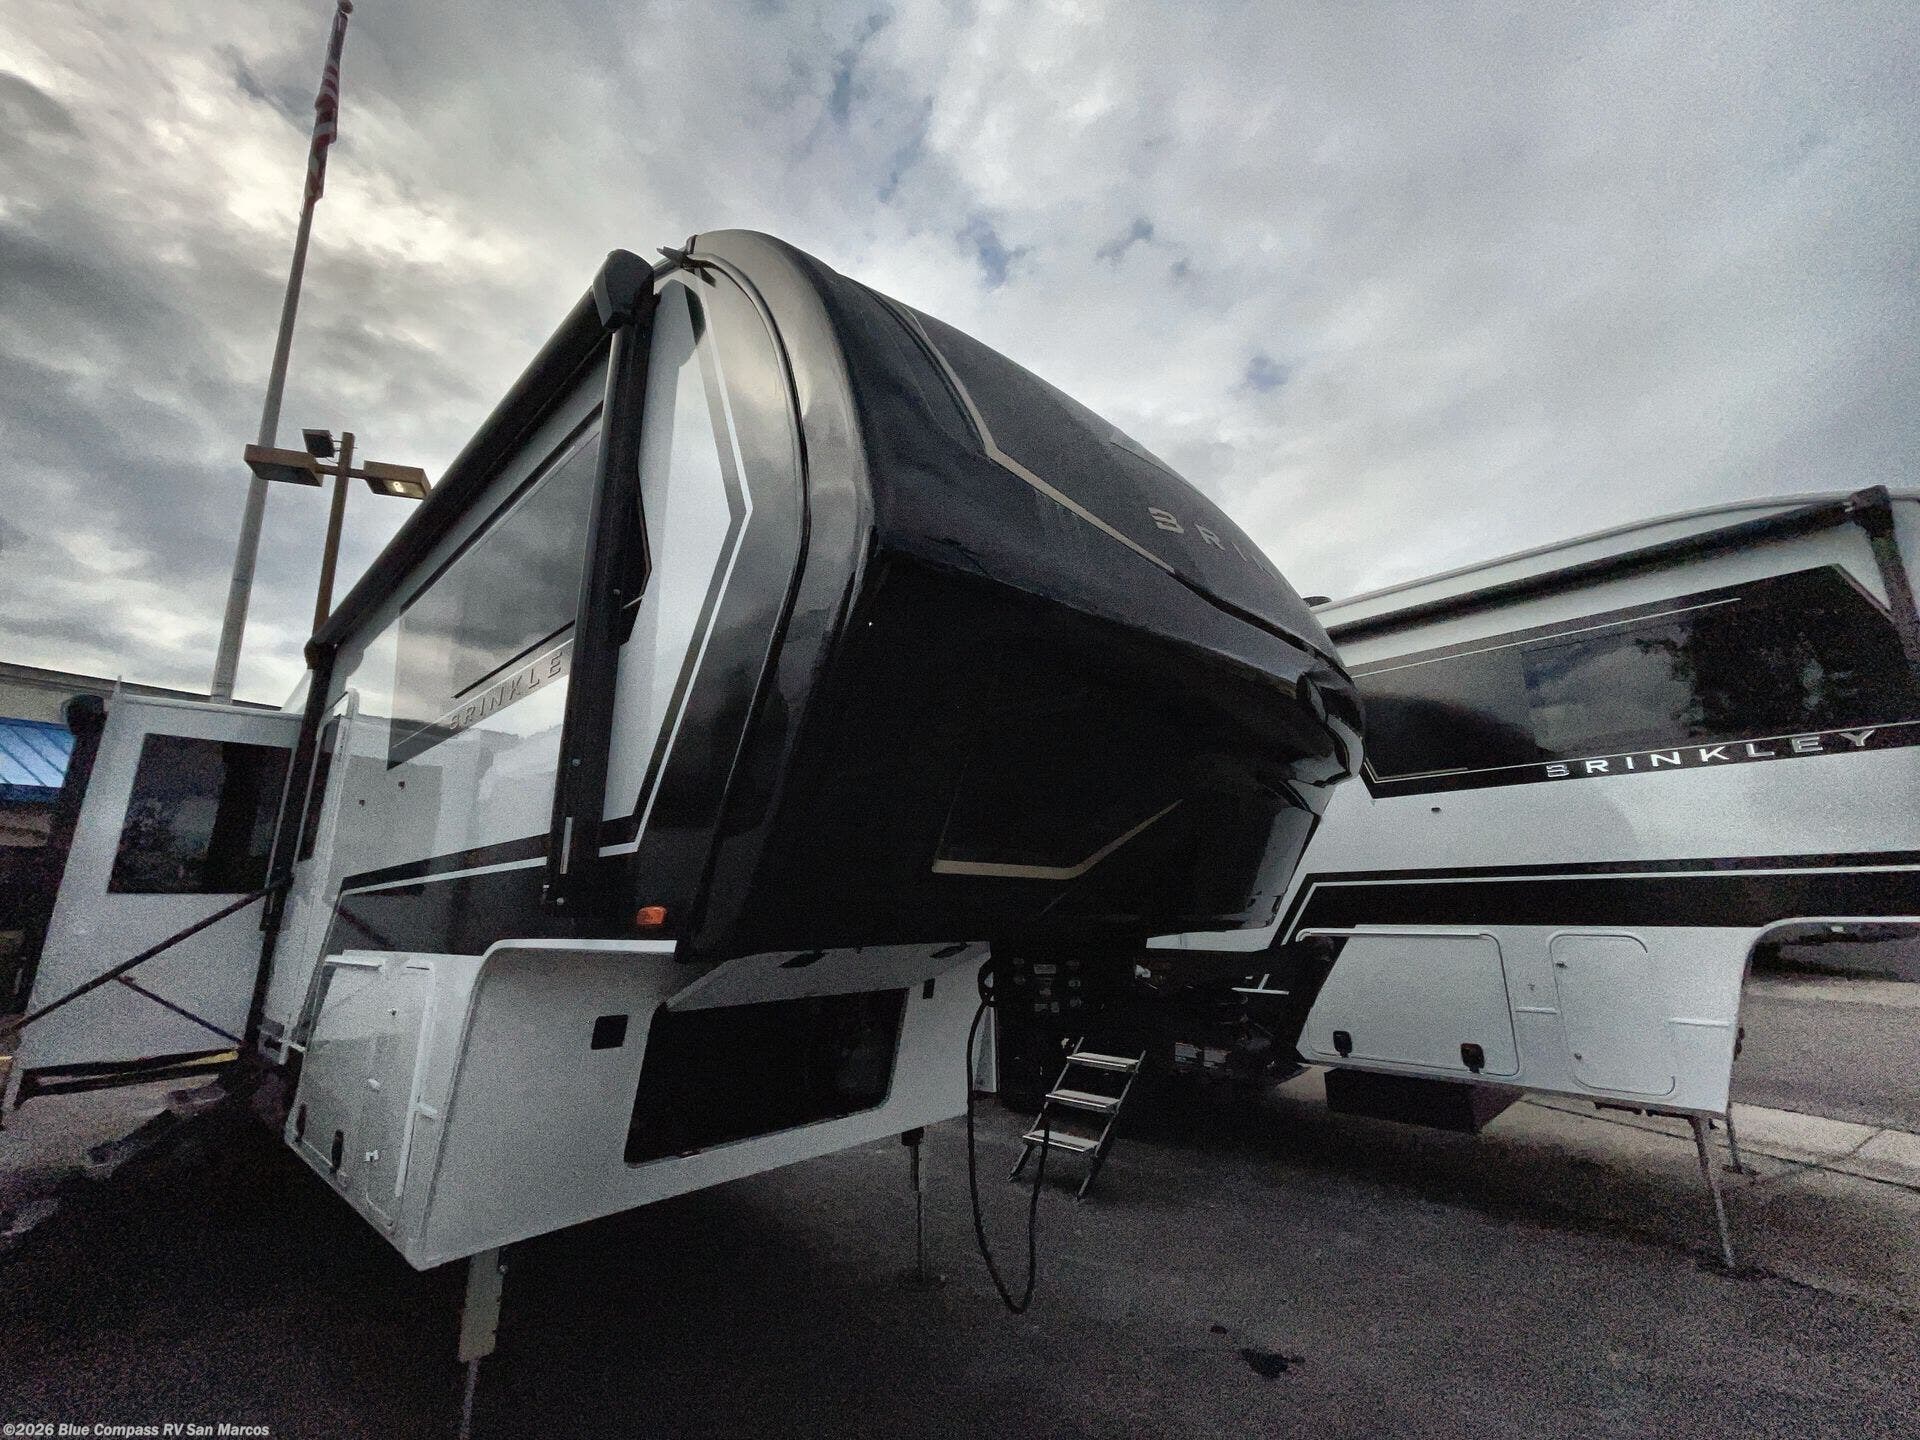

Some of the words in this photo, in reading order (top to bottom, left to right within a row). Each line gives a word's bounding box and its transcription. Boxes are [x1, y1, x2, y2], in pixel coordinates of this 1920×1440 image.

[1148, 506, 1278, 581] BRIN
[449, 651, 563, 730] BRINKLE
[1546, 729, 1876, 778] BRINKLEY
